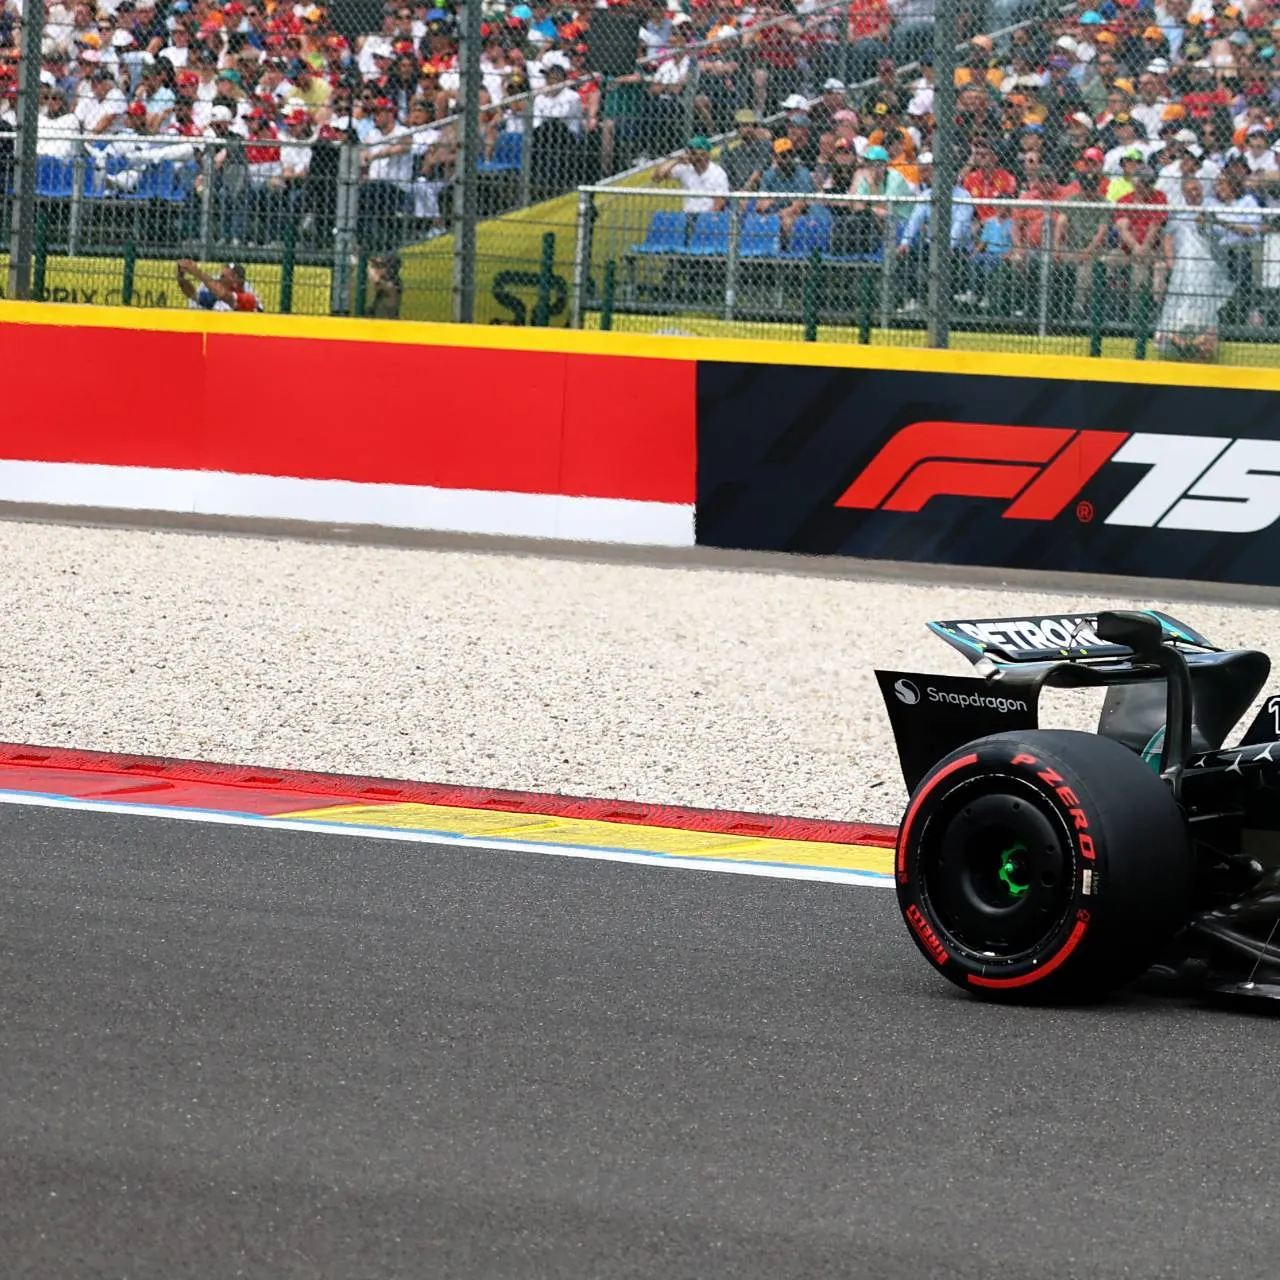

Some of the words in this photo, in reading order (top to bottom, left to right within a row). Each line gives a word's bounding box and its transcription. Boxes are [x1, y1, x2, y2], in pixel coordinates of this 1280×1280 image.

[835, 421, 1130, 521] F1
[926, 686, 1028, 713] Snapdragon
[1035, 767, 1097, 860] ZERO
